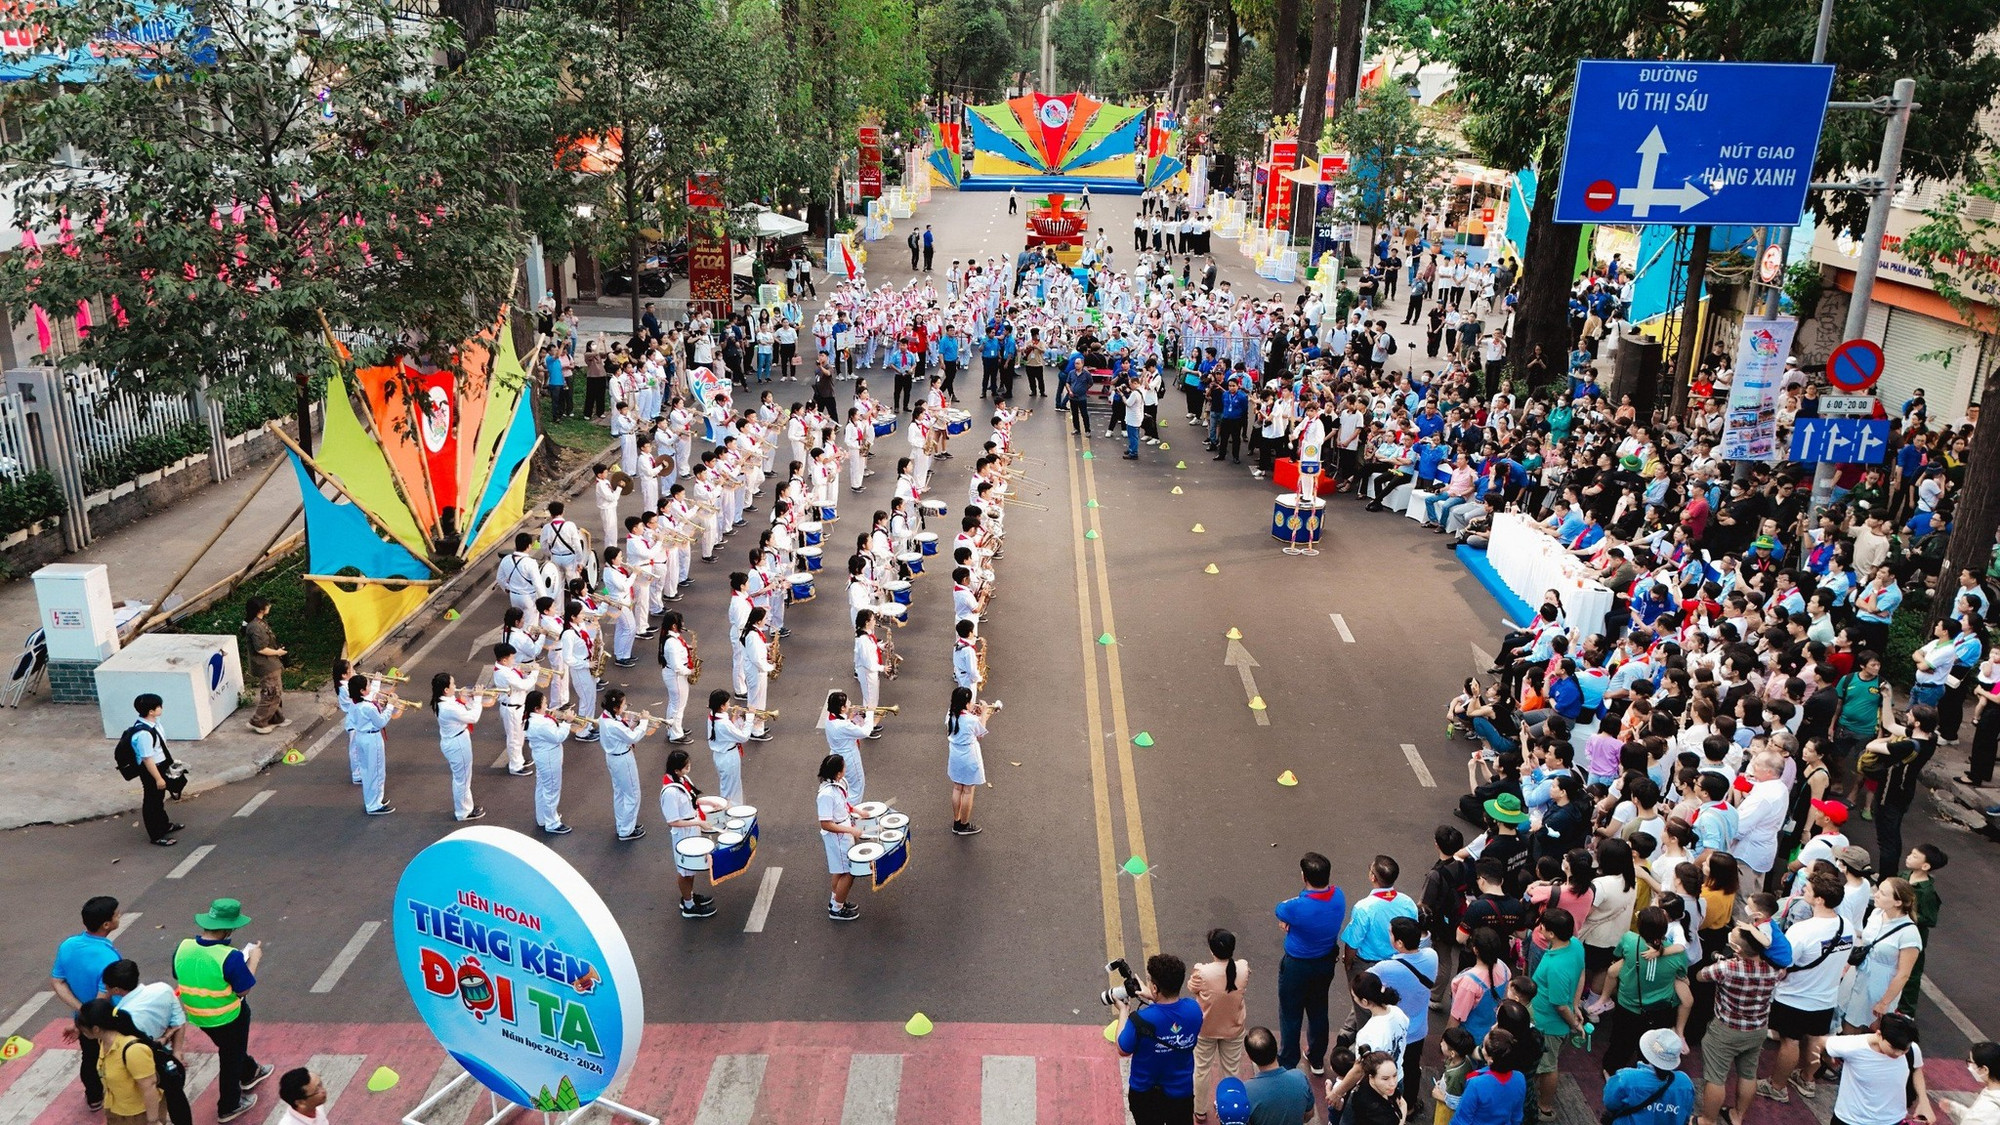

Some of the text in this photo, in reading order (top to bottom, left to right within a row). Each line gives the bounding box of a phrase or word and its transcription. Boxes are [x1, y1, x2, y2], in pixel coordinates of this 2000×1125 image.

[1639, 65, 1698, 83] ĐƯỜNG
[1617, 89, 1708, 114] VÕ THỊ SÁU
[1719, 142, 1795, 159] NÚT GIAO
[1703, 163, 1796, 186] HÀNG XANH
[694, 255, 725, 270] 2024
[1890, 263, 1907, 274] PHẠM
[1907, 266, 1923, 278] NGỌC
[211, 682, 229, 700] VNPT
[457, 890, 541, 931] LIÊN HOAN
[408, 900, 597, 990] TIẾNG KÈN
[420, 947, 604, 1056] ĐỘI TA
[502, 1028, 524, 1044] Năm
[525, 1036, 543, 1052] học
[544, 1044, 569, 1062] 2023
[577, 1057, 603, 1075] 2024
